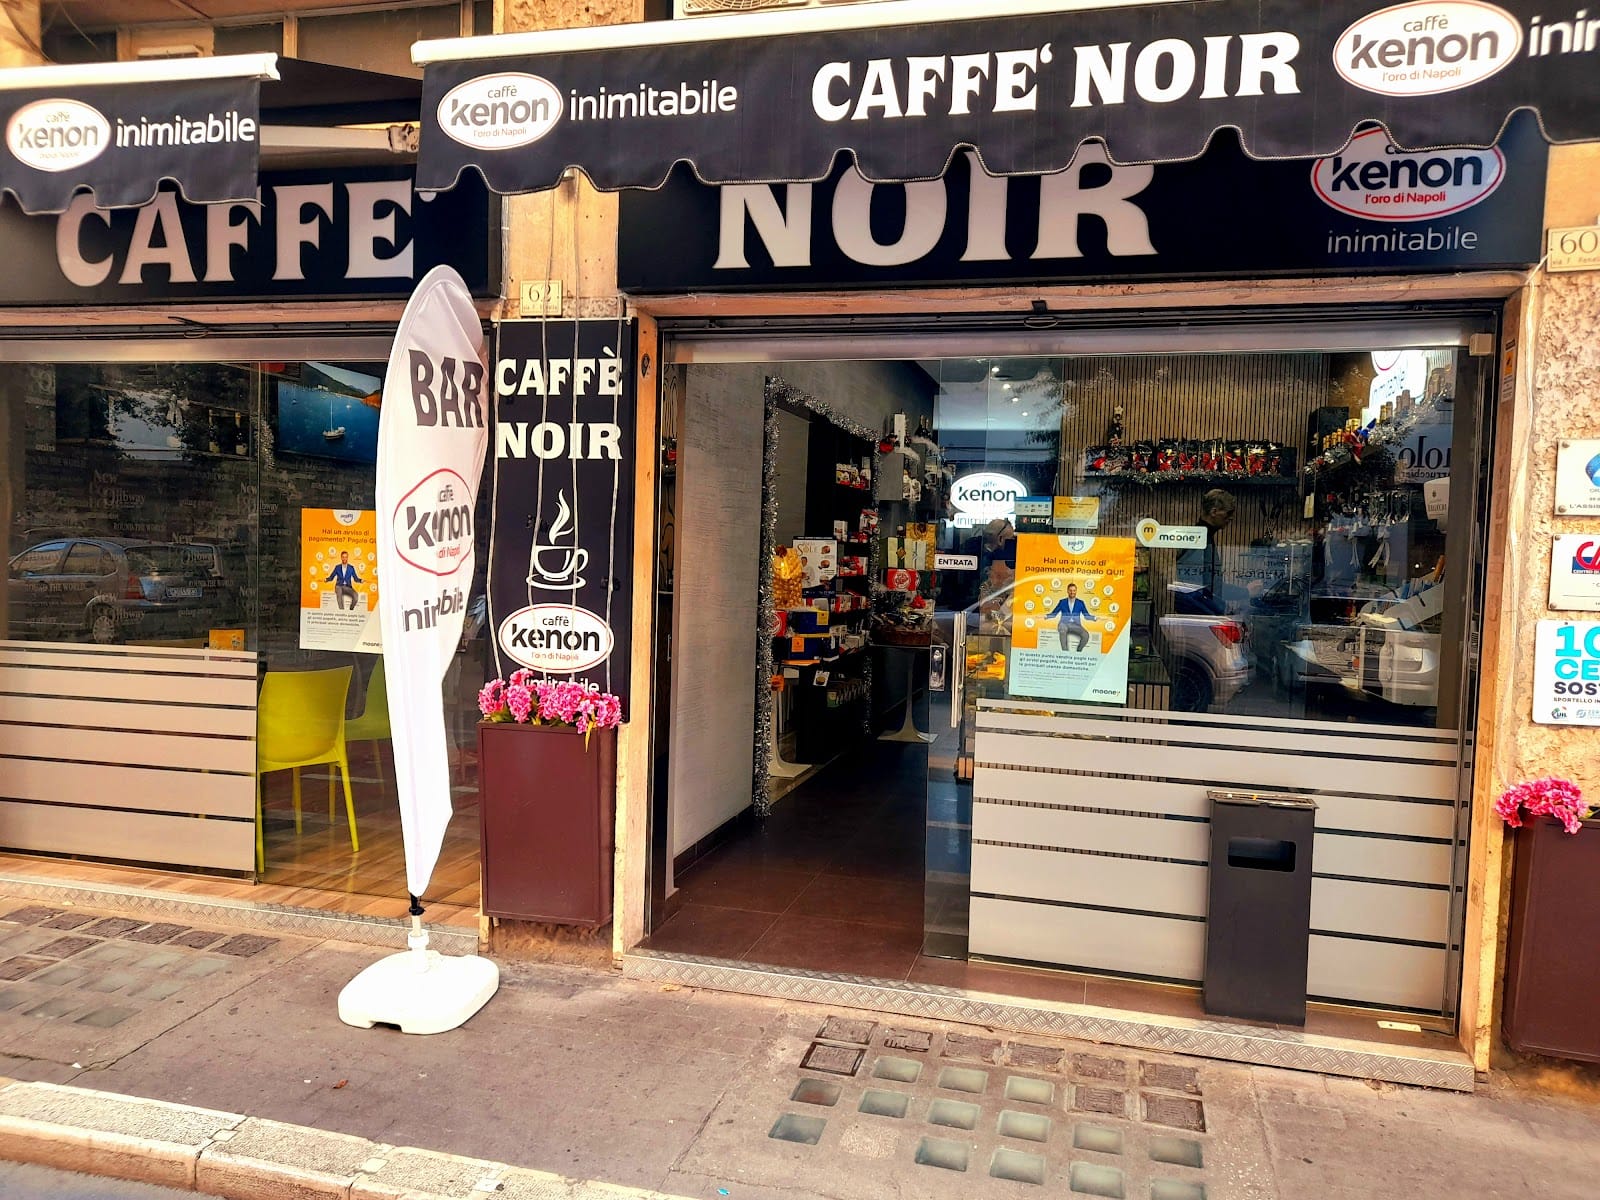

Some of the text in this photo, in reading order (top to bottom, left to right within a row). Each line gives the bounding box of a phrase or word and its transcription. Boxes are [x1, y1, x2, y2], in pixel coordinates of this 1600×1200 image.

[1403, 14, 1449, 33] caffè
[1350, 30, 1499, 70] kenon
[1070, 31, 1301, 109] NOIR
[1382, 67, 1462, 82] l'oro di Napoli
[487, 84, 518, 99] caffè
[569, 79, 738, 122] inimitabile
[450, 97, 549, 127] kenon
[19, 123, 98, 149] kenon
[115, 111, 256, 148] inimitabile
[493, 128, 500, 137] di
[501, 127, 527, 138] Napoli
[1331, 154, 1483, 192] kenon
[712, 143, 1159, 270] NOIR
[1365, 190, 1446, 205] l'oro di Napoli
[1327, 226, 1479, 254] inimitabile
[1560, 230, 1599, 255] 60
[529, 284, 551, 303] 62
[497, 346, 623, 397] CAFFÈ
[408, 349, 485, 429] BAR
[497, 422, 623, 460] NOIR
[958, 486, 1017, 502] kenon
[1159, 534, 1201, 544] mooney
[938, 558, 973, 567] ENTRATA
[1025, 565, 1075, 575] pagamento?
[1076, 567, 1104, 576] Pagalo
[1070, 559, 1097, 567] avviso
[1098, 559, 1106, 567] di
[542, 615, 570, 627] caffè
[511, 623, 600, 652] kenon
[1092, 688, 1121, 697] mooney
[1553, 681, 1600, 696] SOS
